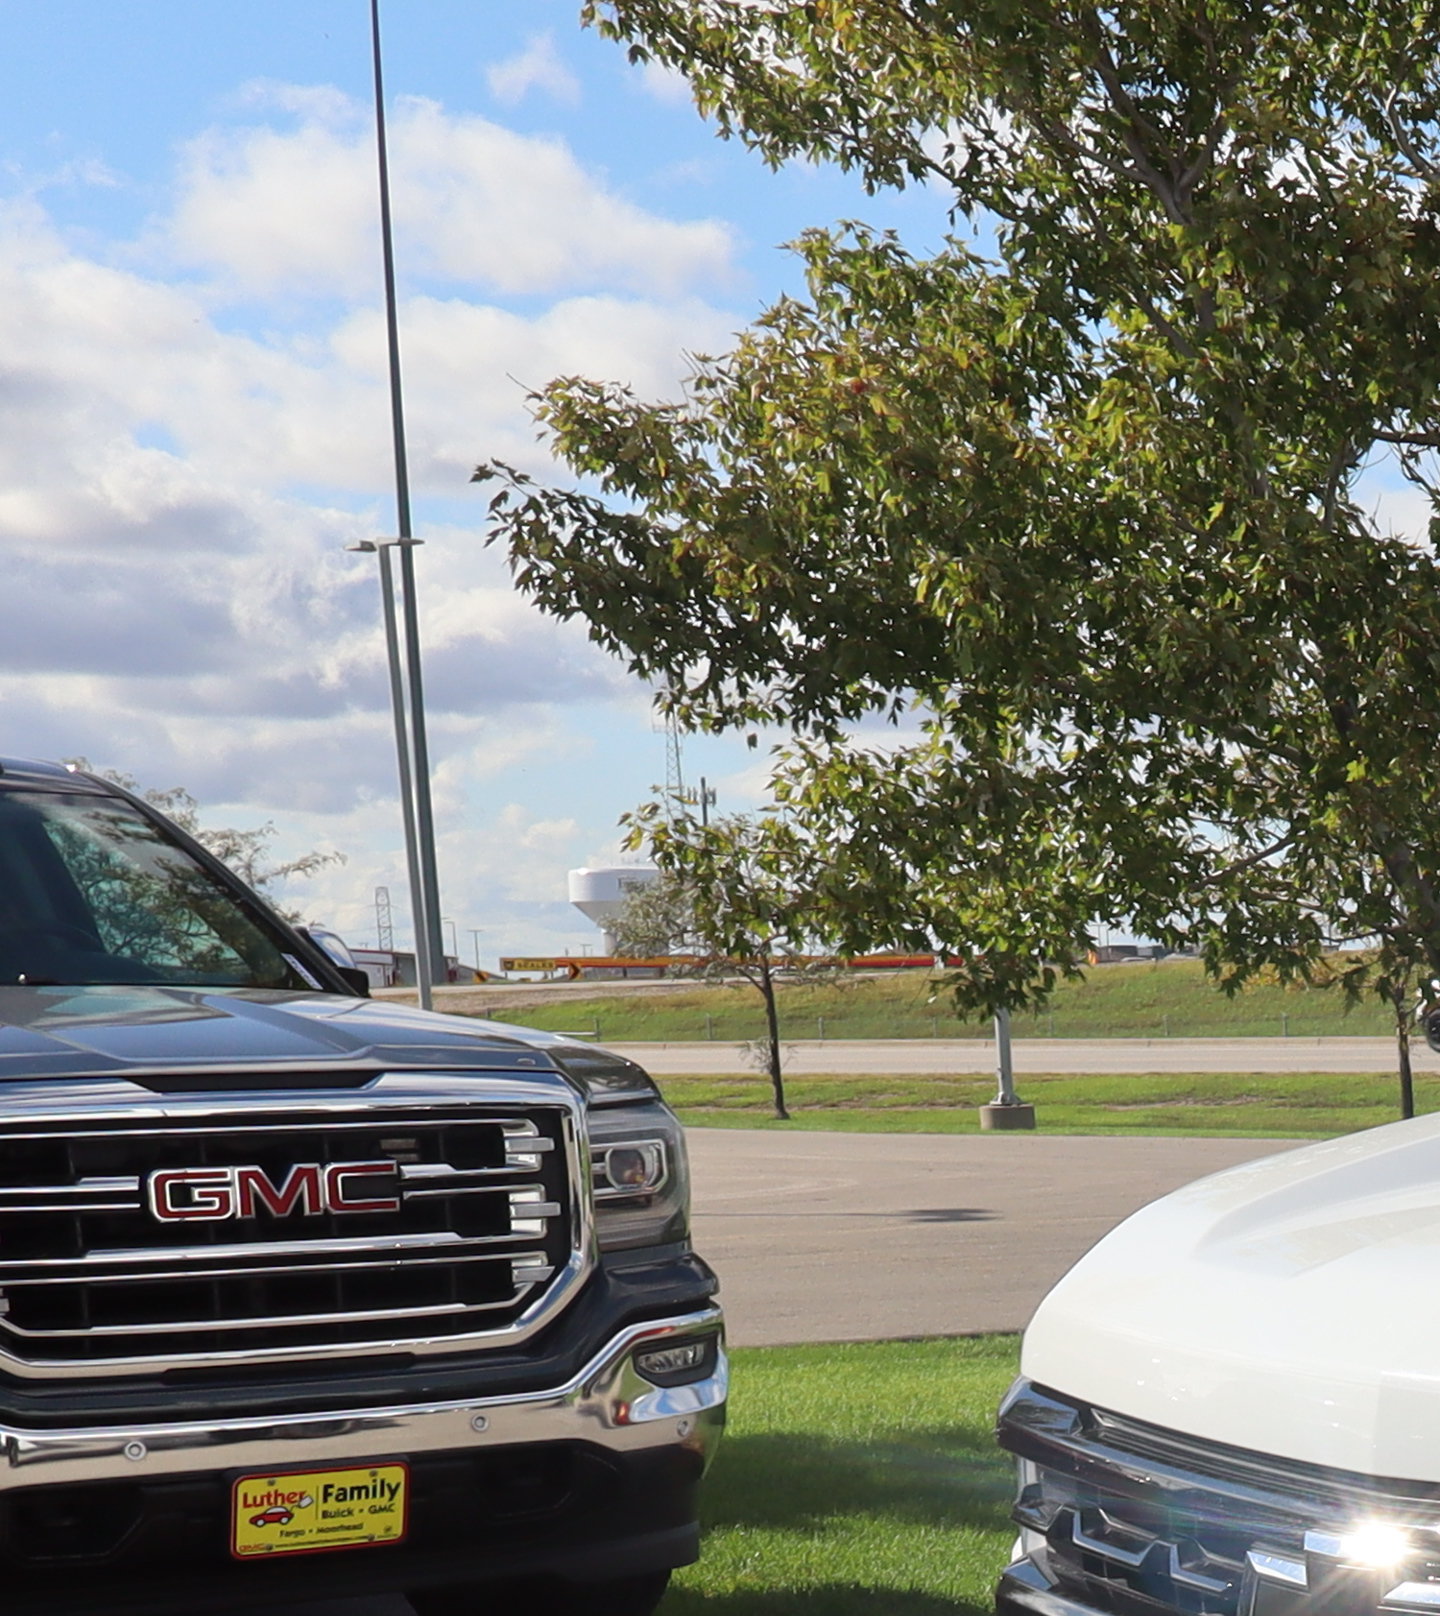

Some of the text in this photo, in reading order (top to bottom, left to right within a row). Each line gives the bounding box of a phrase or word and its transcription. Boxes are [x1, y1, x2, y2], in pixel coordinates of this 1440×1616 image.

[147, 1161, 399, 1223] GMC
[242, 1479, 401, 1509] Luther Family
[321, 1503, 396, 1520] Buick GMC
